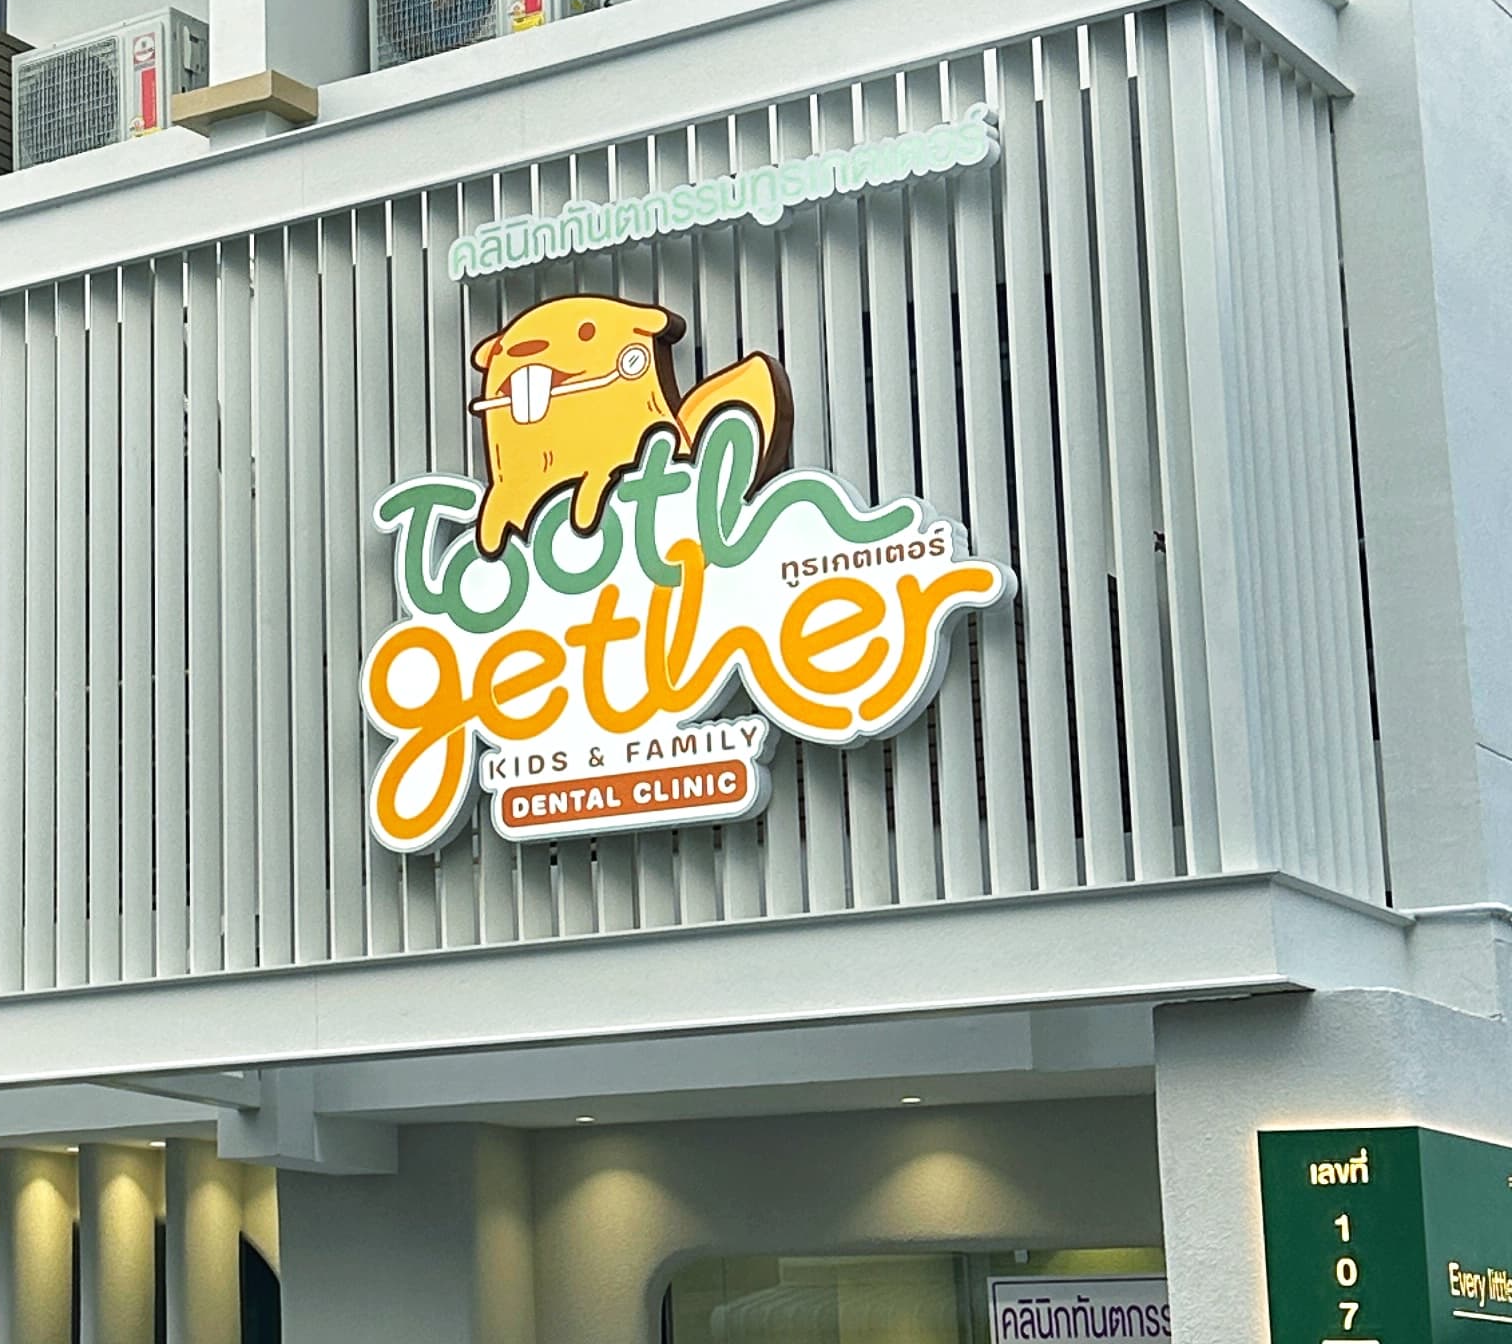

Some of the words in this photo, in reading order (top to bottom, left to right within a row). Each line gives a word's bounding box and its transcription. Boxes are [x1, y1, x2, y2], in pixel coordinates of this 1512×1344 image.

[379, 416, 915, 634] Tooth
[368, 539, 994, 841] gether
[488, 751, 568, 780] KIDS
[588, 747, 605, 768] &
[626, 725, 758, 763] FAMILY
[511, 786, 621, 819] DENTAL
[632, 770, 737, 806] CLINIC
[1309, 1147, 1369, 1186] เลขที่
[1448, 1261, 1486, 1308] Every
